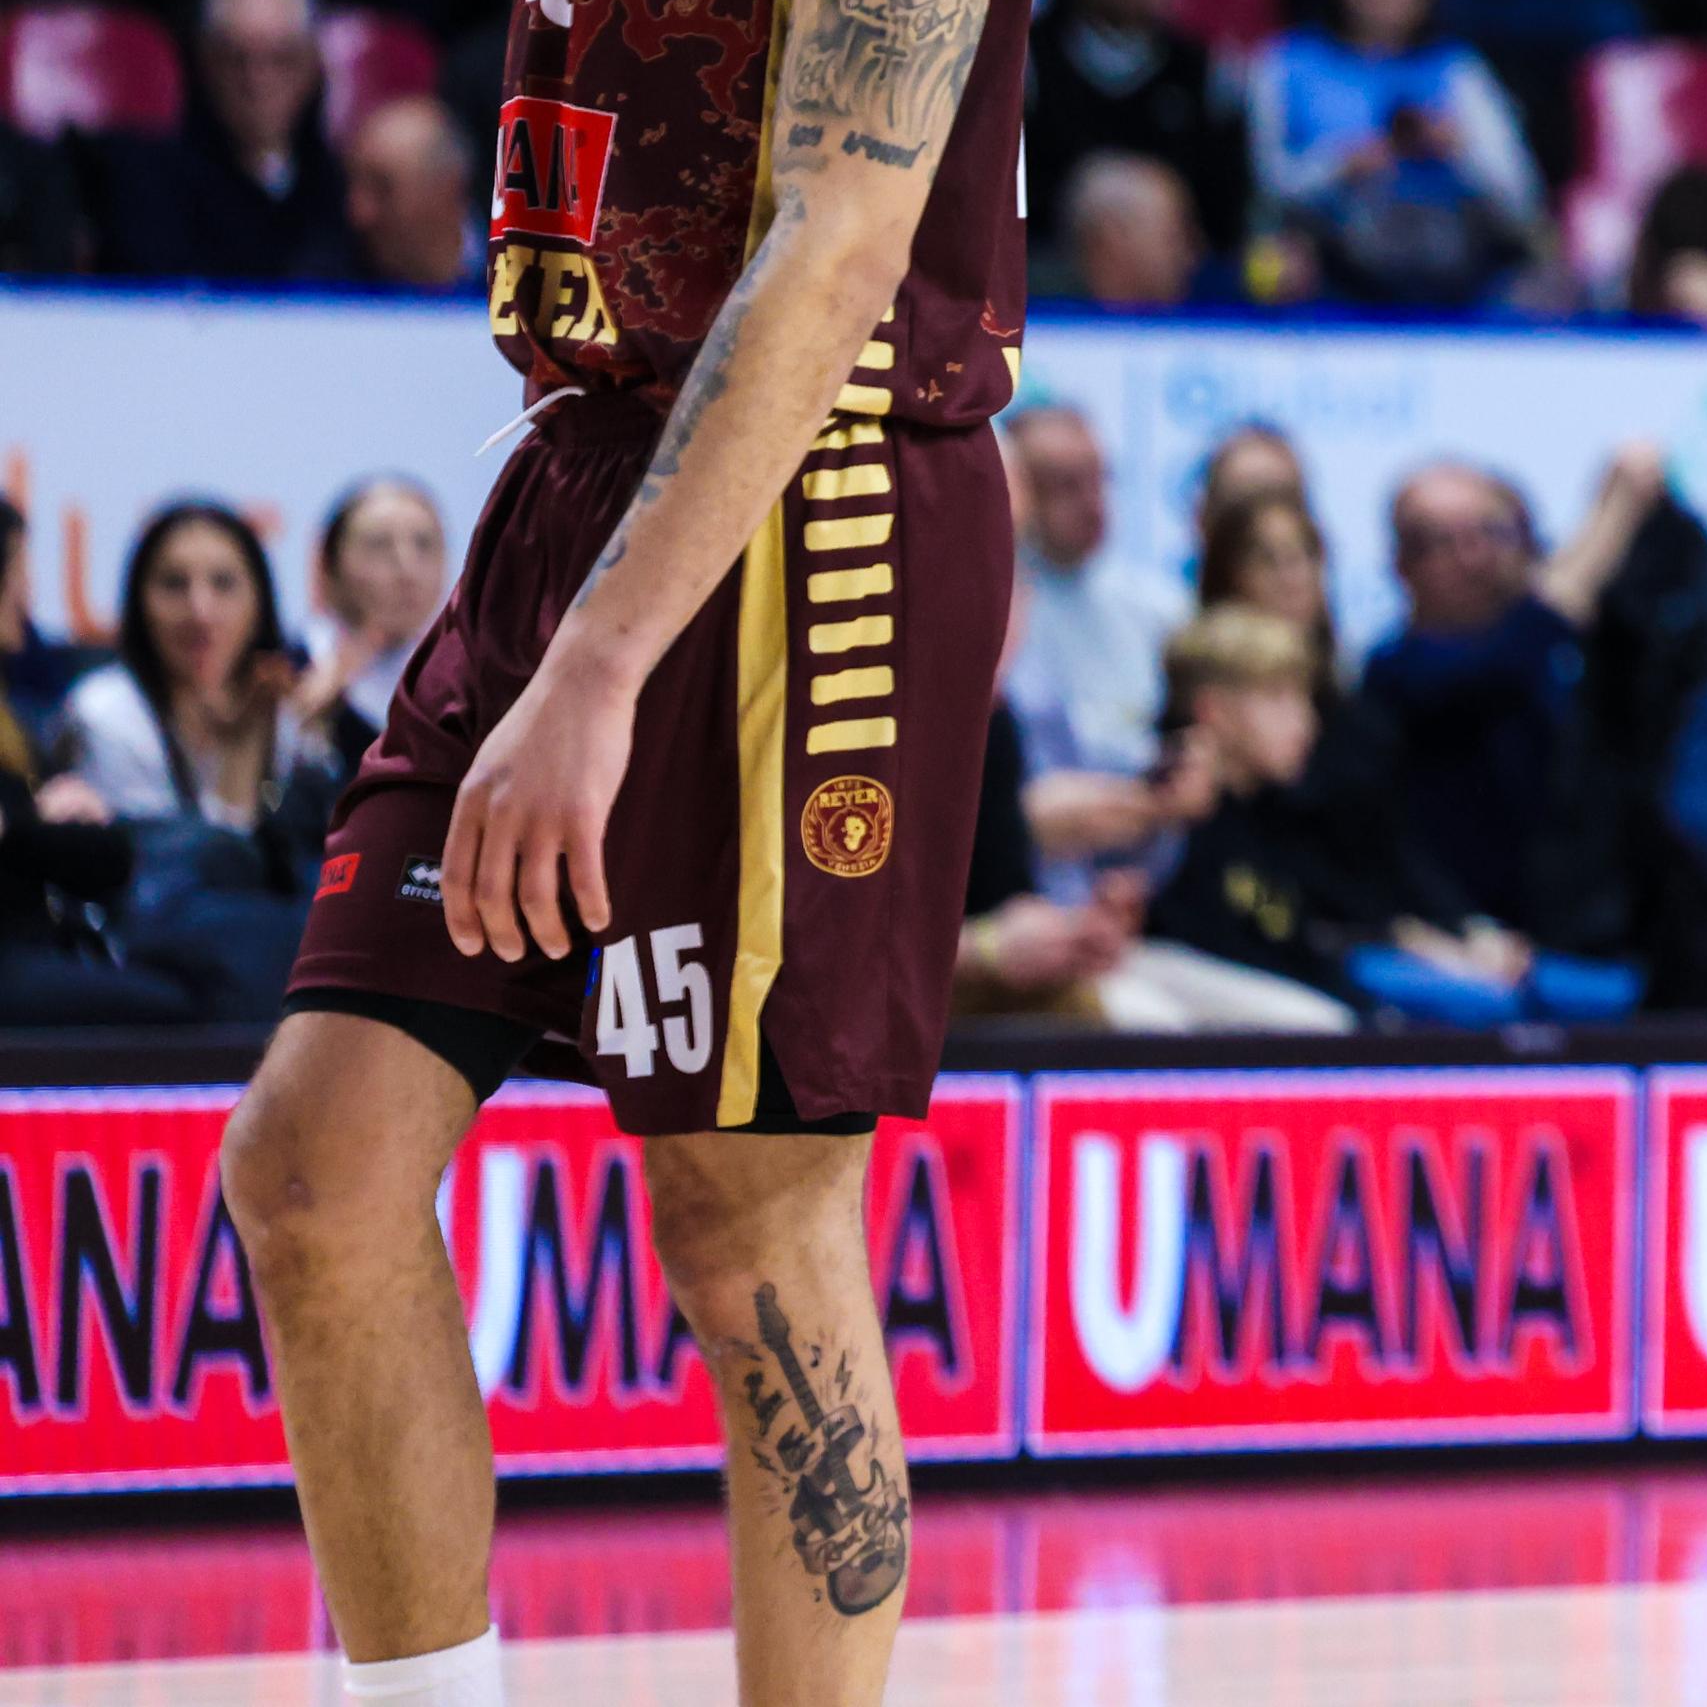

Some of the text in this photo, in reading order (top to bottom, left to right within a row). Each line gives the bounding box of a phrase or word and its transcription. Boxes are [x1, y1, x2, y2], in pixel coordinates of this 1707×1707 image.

[819, 788, 878, 808] REYER
[596, 923, 713, 1078] 45
[1071, 1132, 1590, 1391] UMANA
